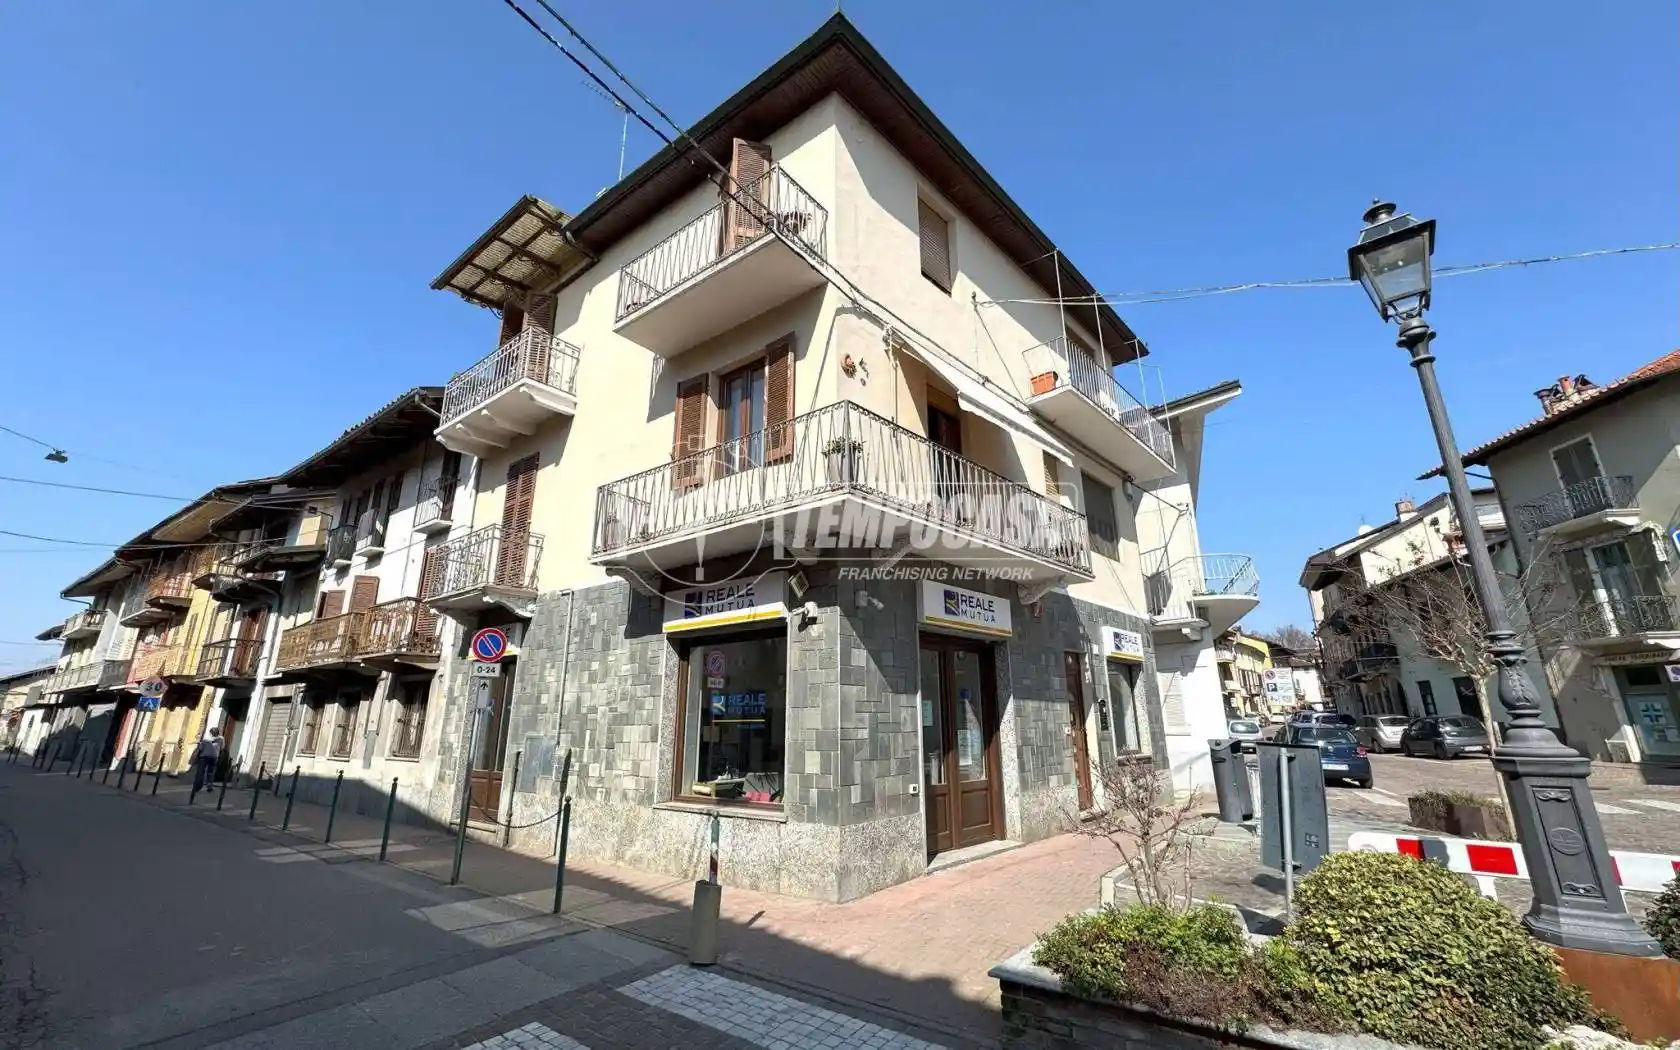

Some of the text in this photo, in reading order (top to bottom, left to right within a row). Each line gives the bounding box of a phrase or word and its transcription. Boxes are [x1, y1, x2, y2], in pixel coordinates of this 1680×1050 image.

[706, 583, 755, 603] REALE
[705, 599, 755, 614] MUTUA
[960, 594, 995, 613] REALE
[961, 609, 997, 623] MUTUA
[477, 666, 496, 674] 0-24
